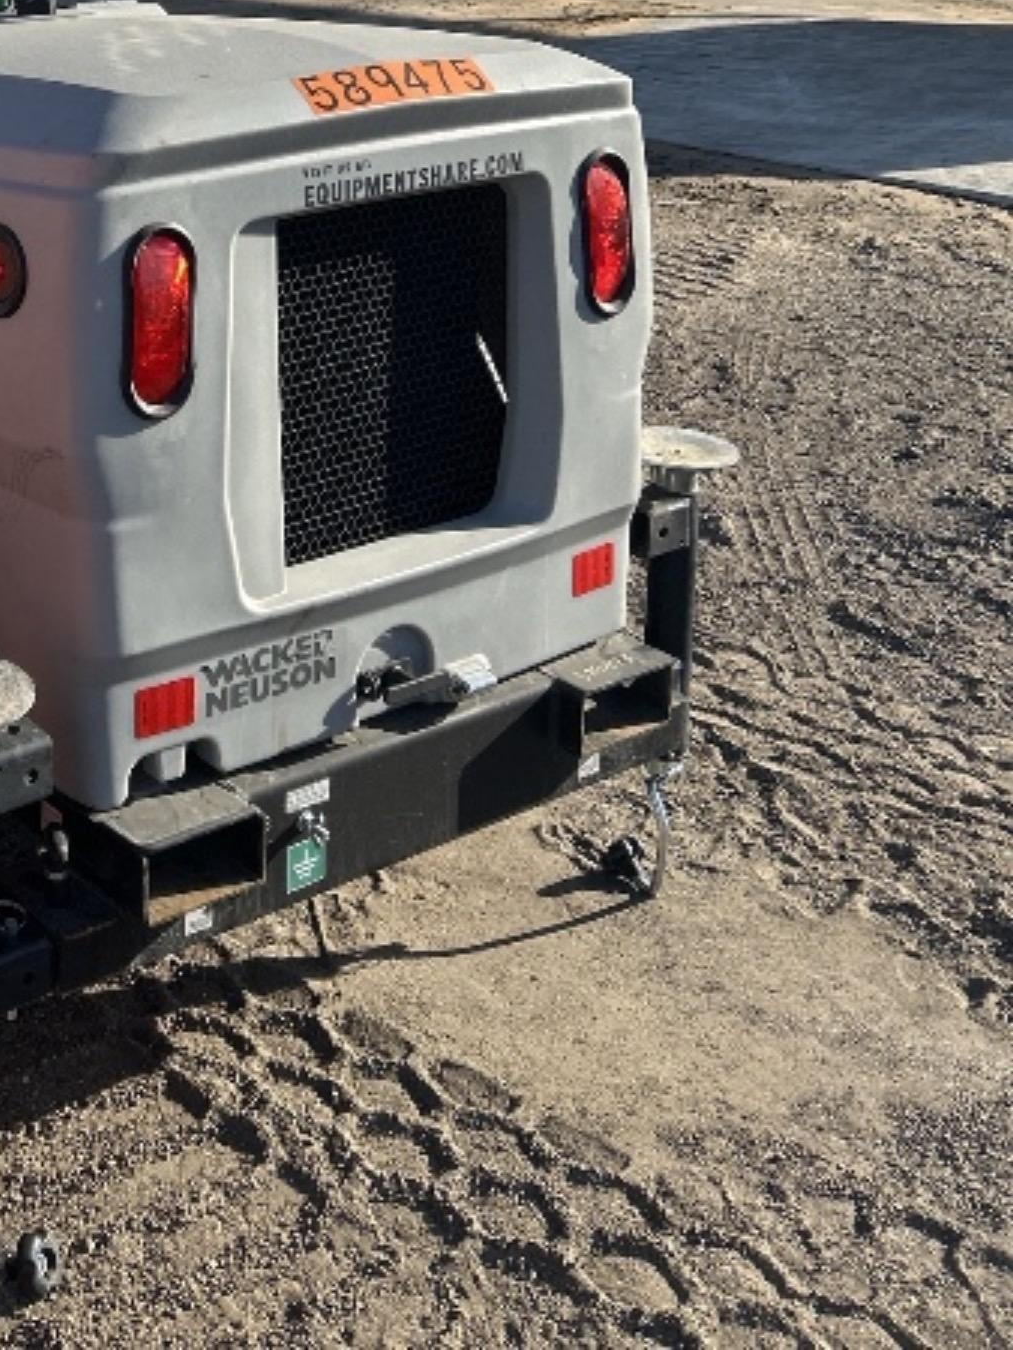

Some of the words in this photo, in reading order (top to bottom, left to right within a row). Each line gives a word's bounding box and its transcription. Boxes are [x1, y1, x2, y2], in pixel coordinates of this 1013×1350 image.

[300, 58, 485, 112] 589475
[304, 152, 525, 208] EQUIPMENTSHARE.COM
[205, 656, 336, 718] NEUSON
